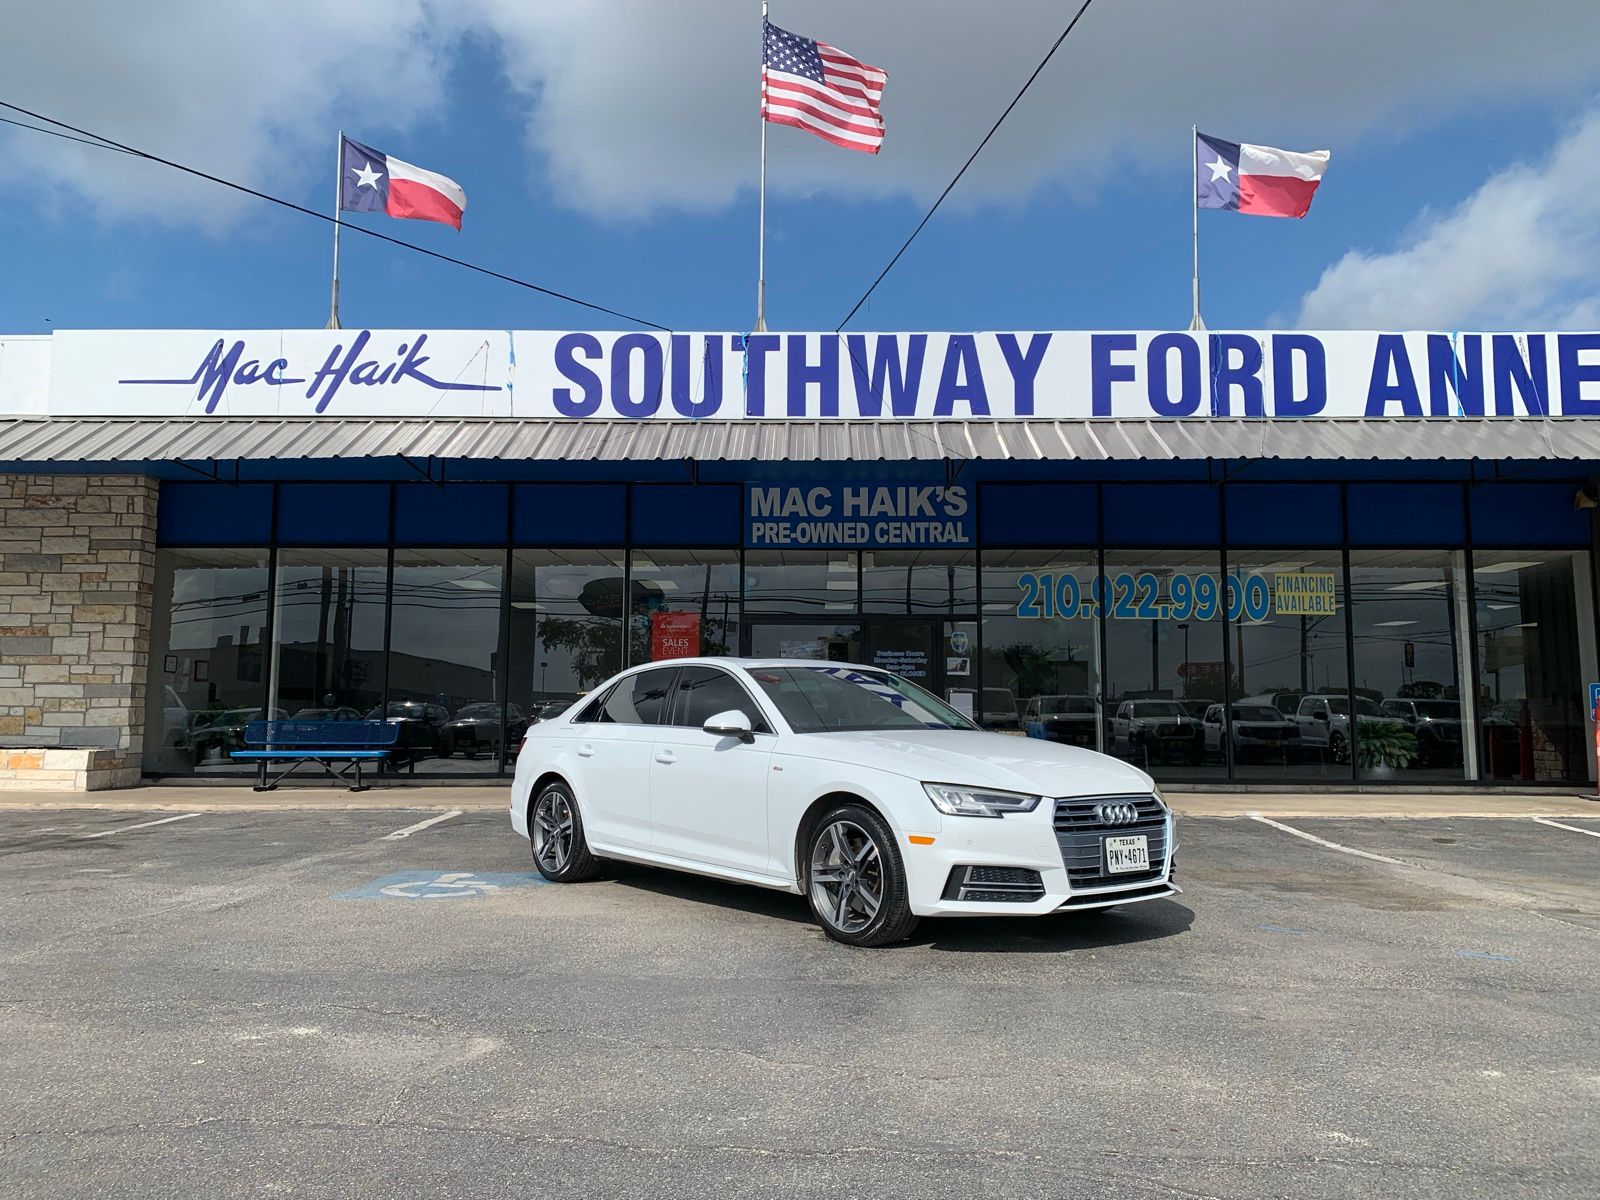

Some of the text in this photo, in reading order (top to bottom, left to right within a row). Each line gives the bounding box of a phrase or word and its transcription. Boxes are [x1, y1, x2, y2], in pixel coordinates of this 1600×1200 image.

[118, 330, 502, 414] Mac Haik
[552, 332, 1600, 417] SOUTHWAY FORD ANNE
[751, 486, 968, 518] MAC HAIK'S
[752, 522, 969, 544] PRE-OWNED CENTRAL
[1276, 575, 1334, 593] FINANCING
[1017, 572, 1271, 622] 210.922.9900
[1276, 593, 1336, 613] AVAILABLE
[662, 638, 689, 647] SALES
[662, 646, 689, 655] EVENT
[1119, 838, 1136, 846] TEXAS
